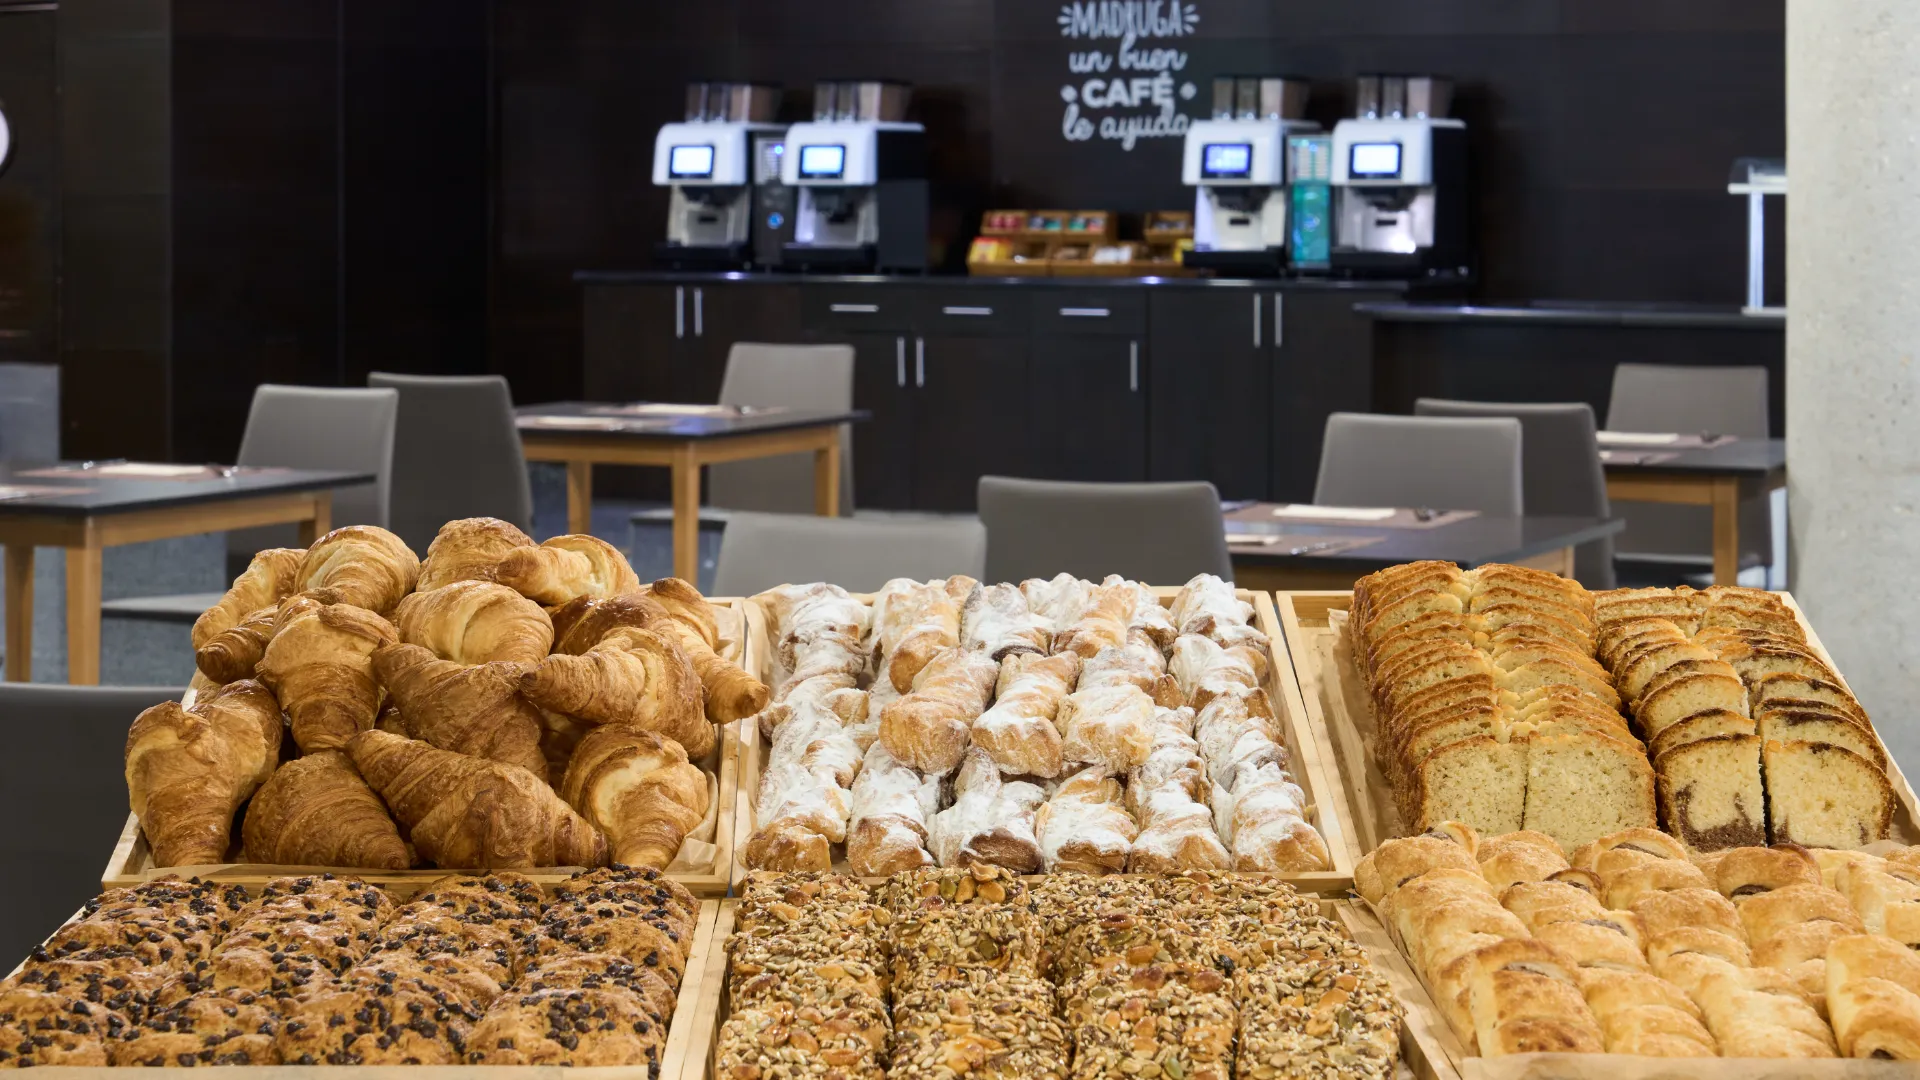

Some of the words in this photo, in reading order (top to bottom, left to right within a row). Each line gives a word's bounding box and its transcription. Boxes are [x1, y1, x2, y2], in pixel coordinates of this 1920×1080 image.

[1070, 0, 1183, 38] MADRUGA
[1069, 50, 1112, 73] un
[1118, 32, 1188, 71] buen
[1081, 71, 1175, 108] CAFÉ
[1100, 97, 1190, 151] ayuda
